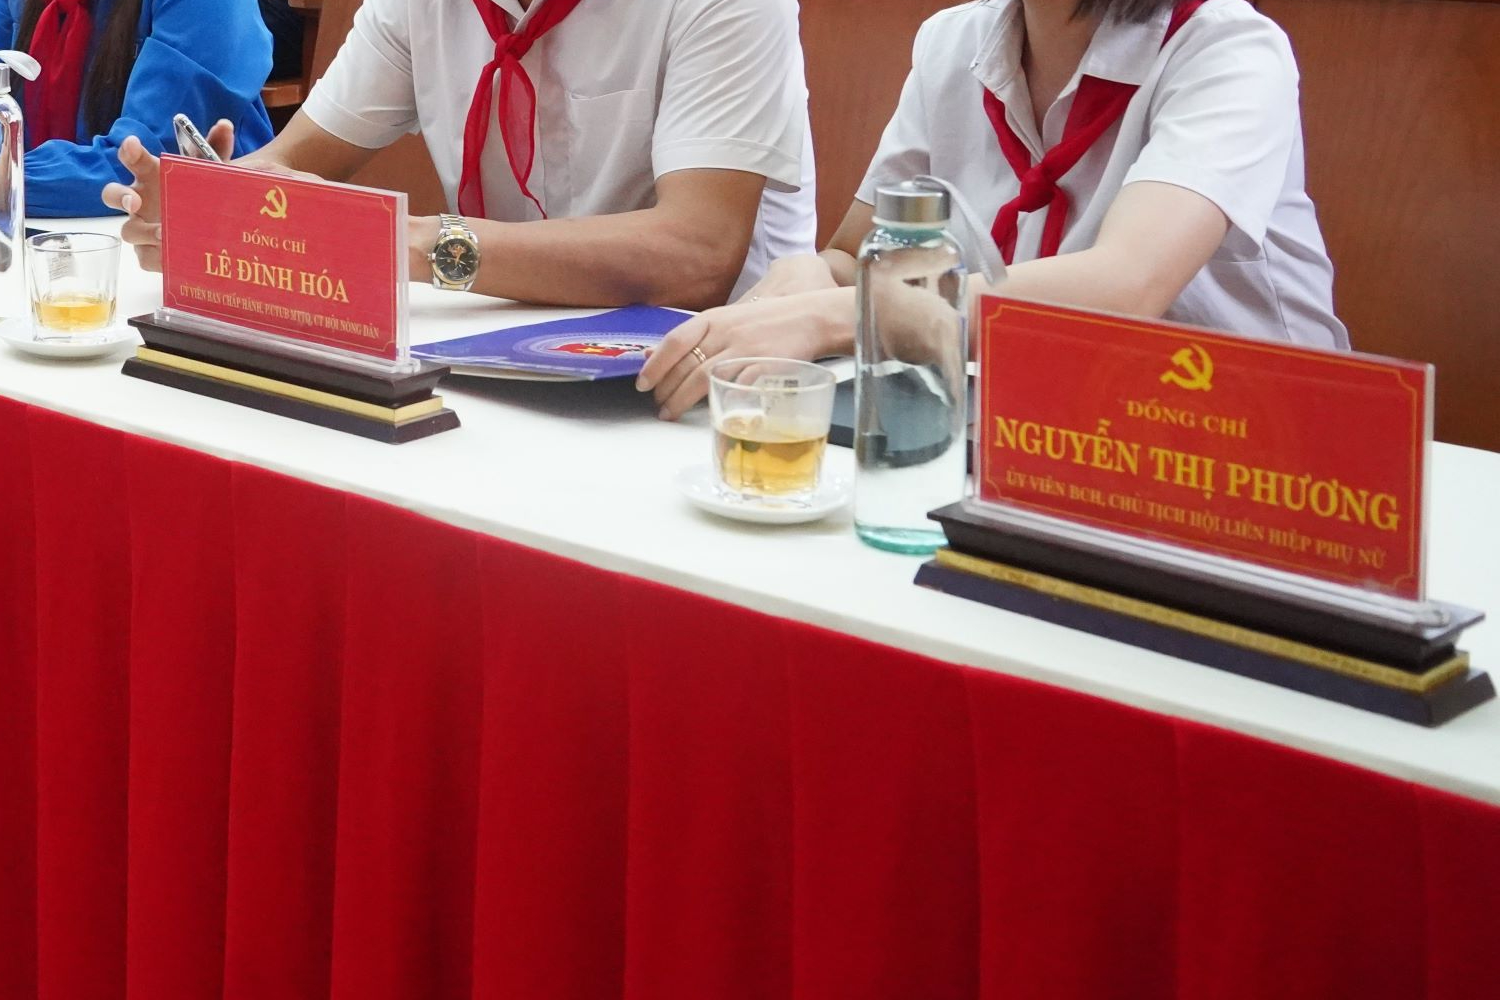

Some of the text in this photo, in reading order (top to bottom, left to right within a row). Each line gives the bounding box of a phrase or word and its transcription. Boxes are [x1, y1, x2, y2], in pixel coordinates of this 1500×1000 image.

[205, 249, 349, 303] LÊ ĐÌNH HÓA
[994, 416, 1400, 532] NGUYỄN THỊ PHƯƠNG
[1029, 474, 1066, 497] VIÊN
[1145, 501, 1185, 524] TỊCH
[1190, 510, 1220, 534] HỘI
[1225, 517, 1264, 541] LIÊN
[1269, 527, 1312, 552] HIỆP
